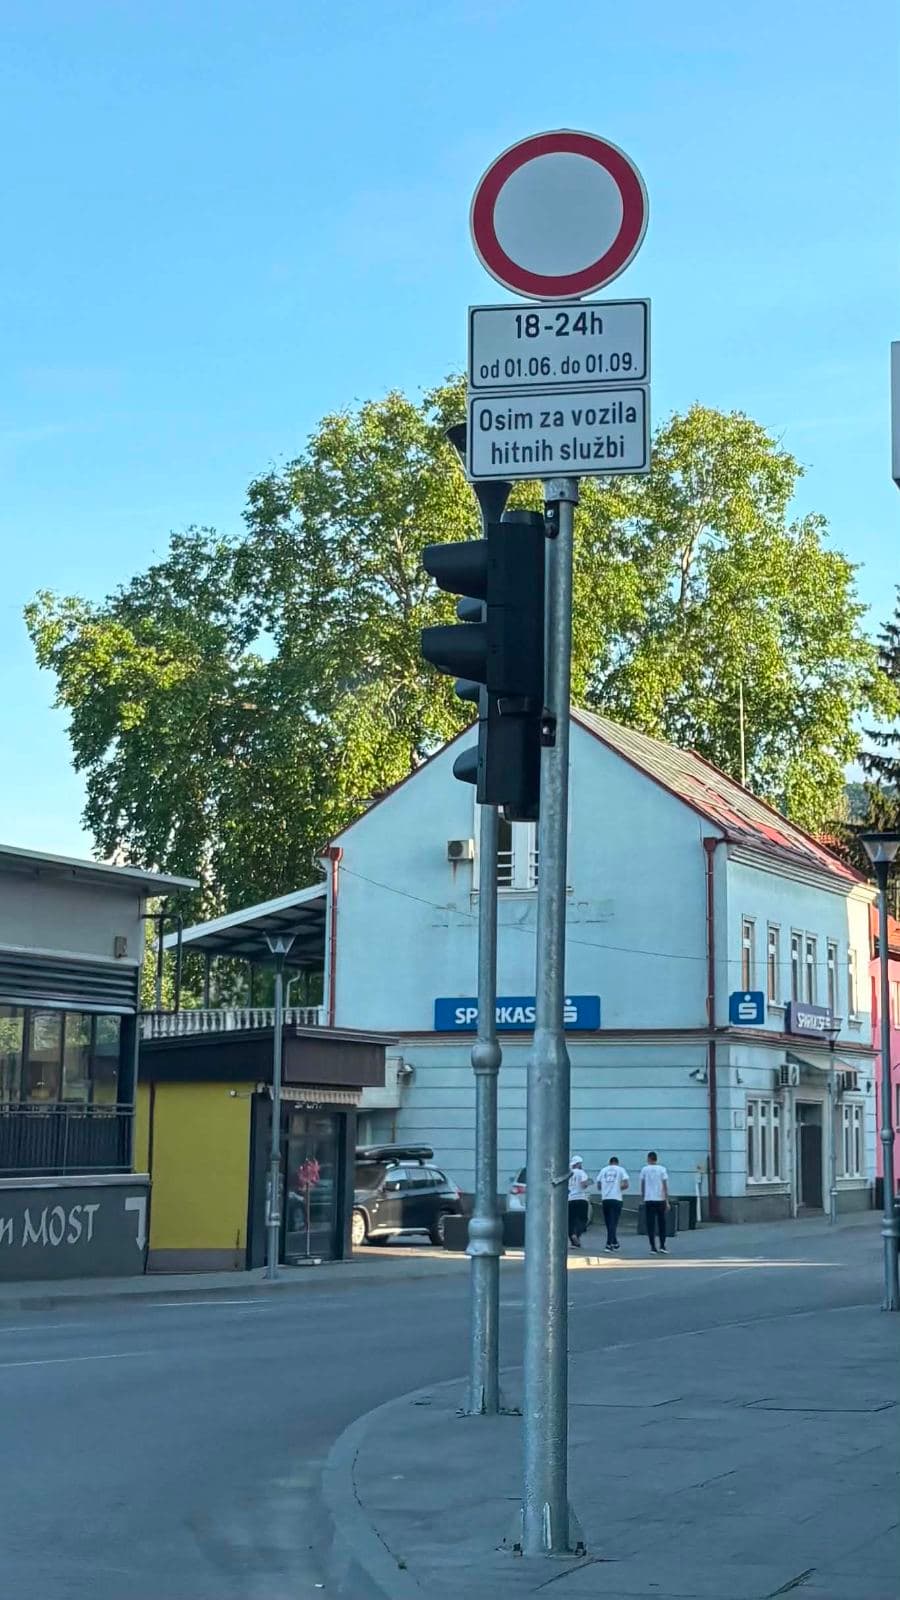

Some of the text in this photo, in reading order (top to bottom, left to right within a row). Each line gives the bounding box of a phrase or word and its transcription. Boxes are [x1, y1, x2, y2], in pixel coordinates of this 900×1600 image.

[515, 311, 603, 339] 18-24h
[480, 352, 638, 379] od 01.06. do 01.09.
[479, 401, 637, 432] Osim za vozila
[491, 435, 625, 465] hitnih službi
[22, 1203, 101, 1248] MOST
